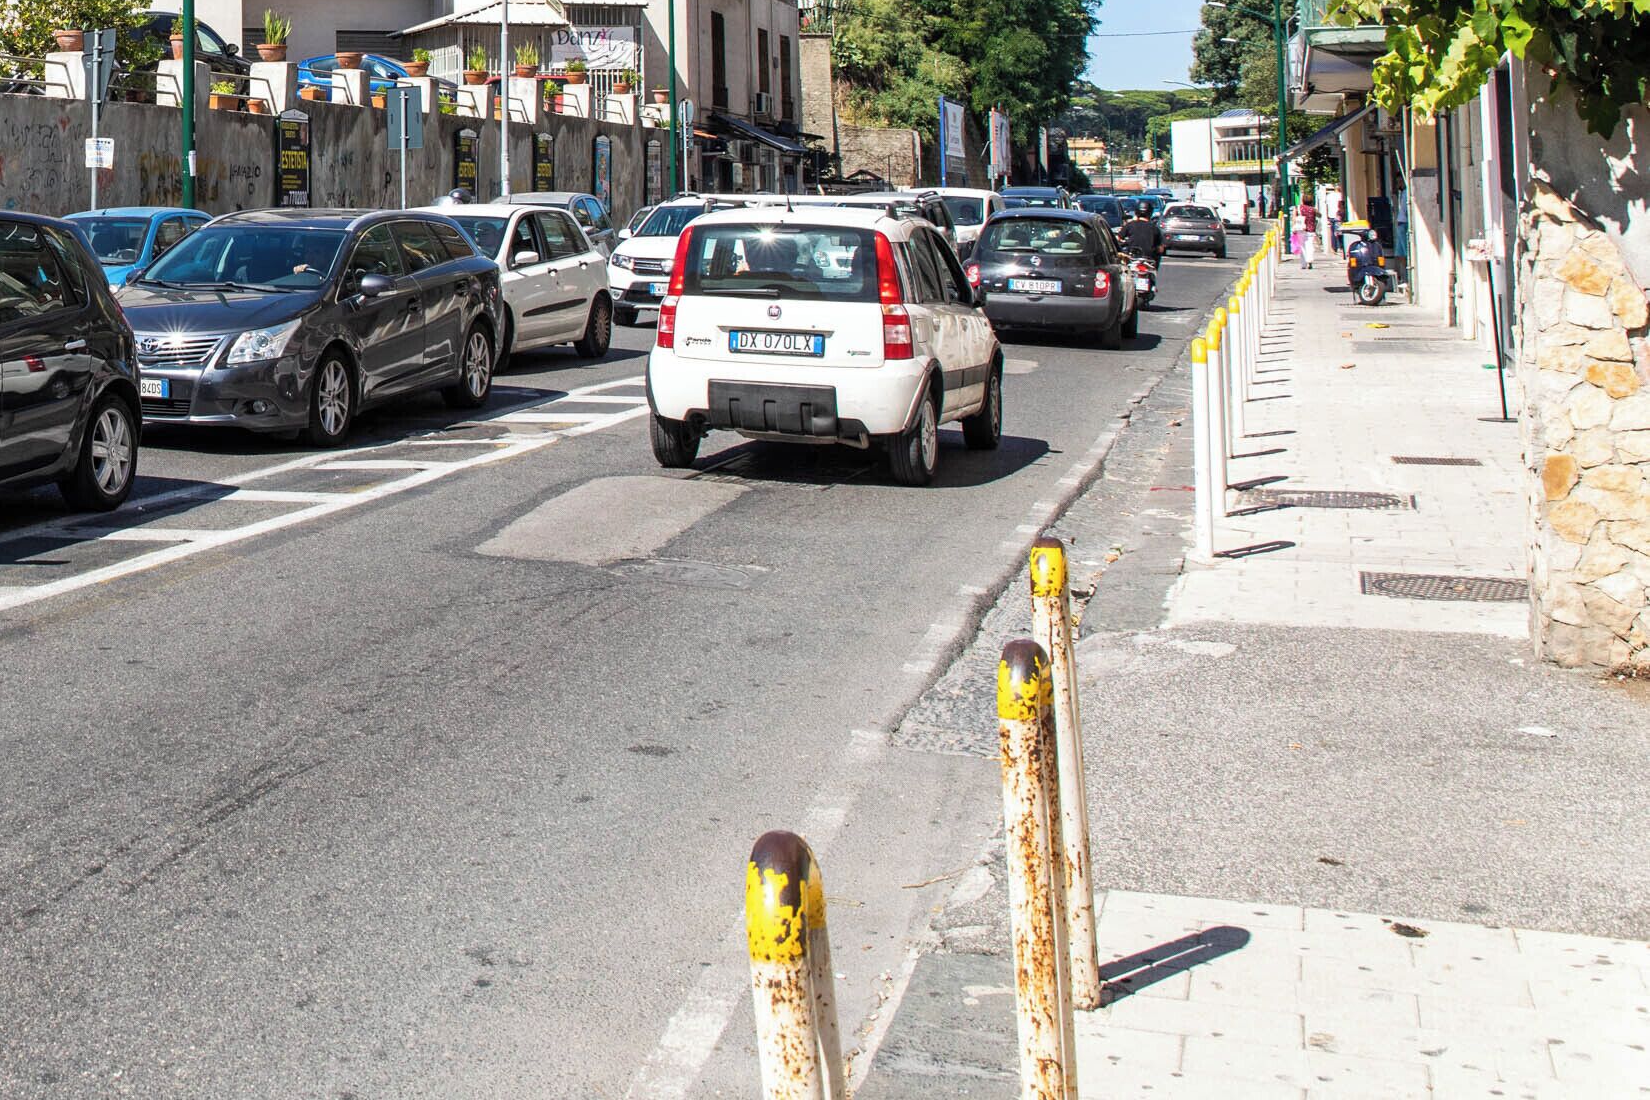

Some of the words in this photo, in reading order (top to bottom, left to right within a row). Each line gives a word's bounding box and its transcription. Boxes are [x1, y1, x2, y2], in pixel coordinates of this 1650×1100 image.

[282, 151, 307, 169] ESTETISTA
[740, 333, 757, 348] DX
[764, 334, 812, 351] 070LX
